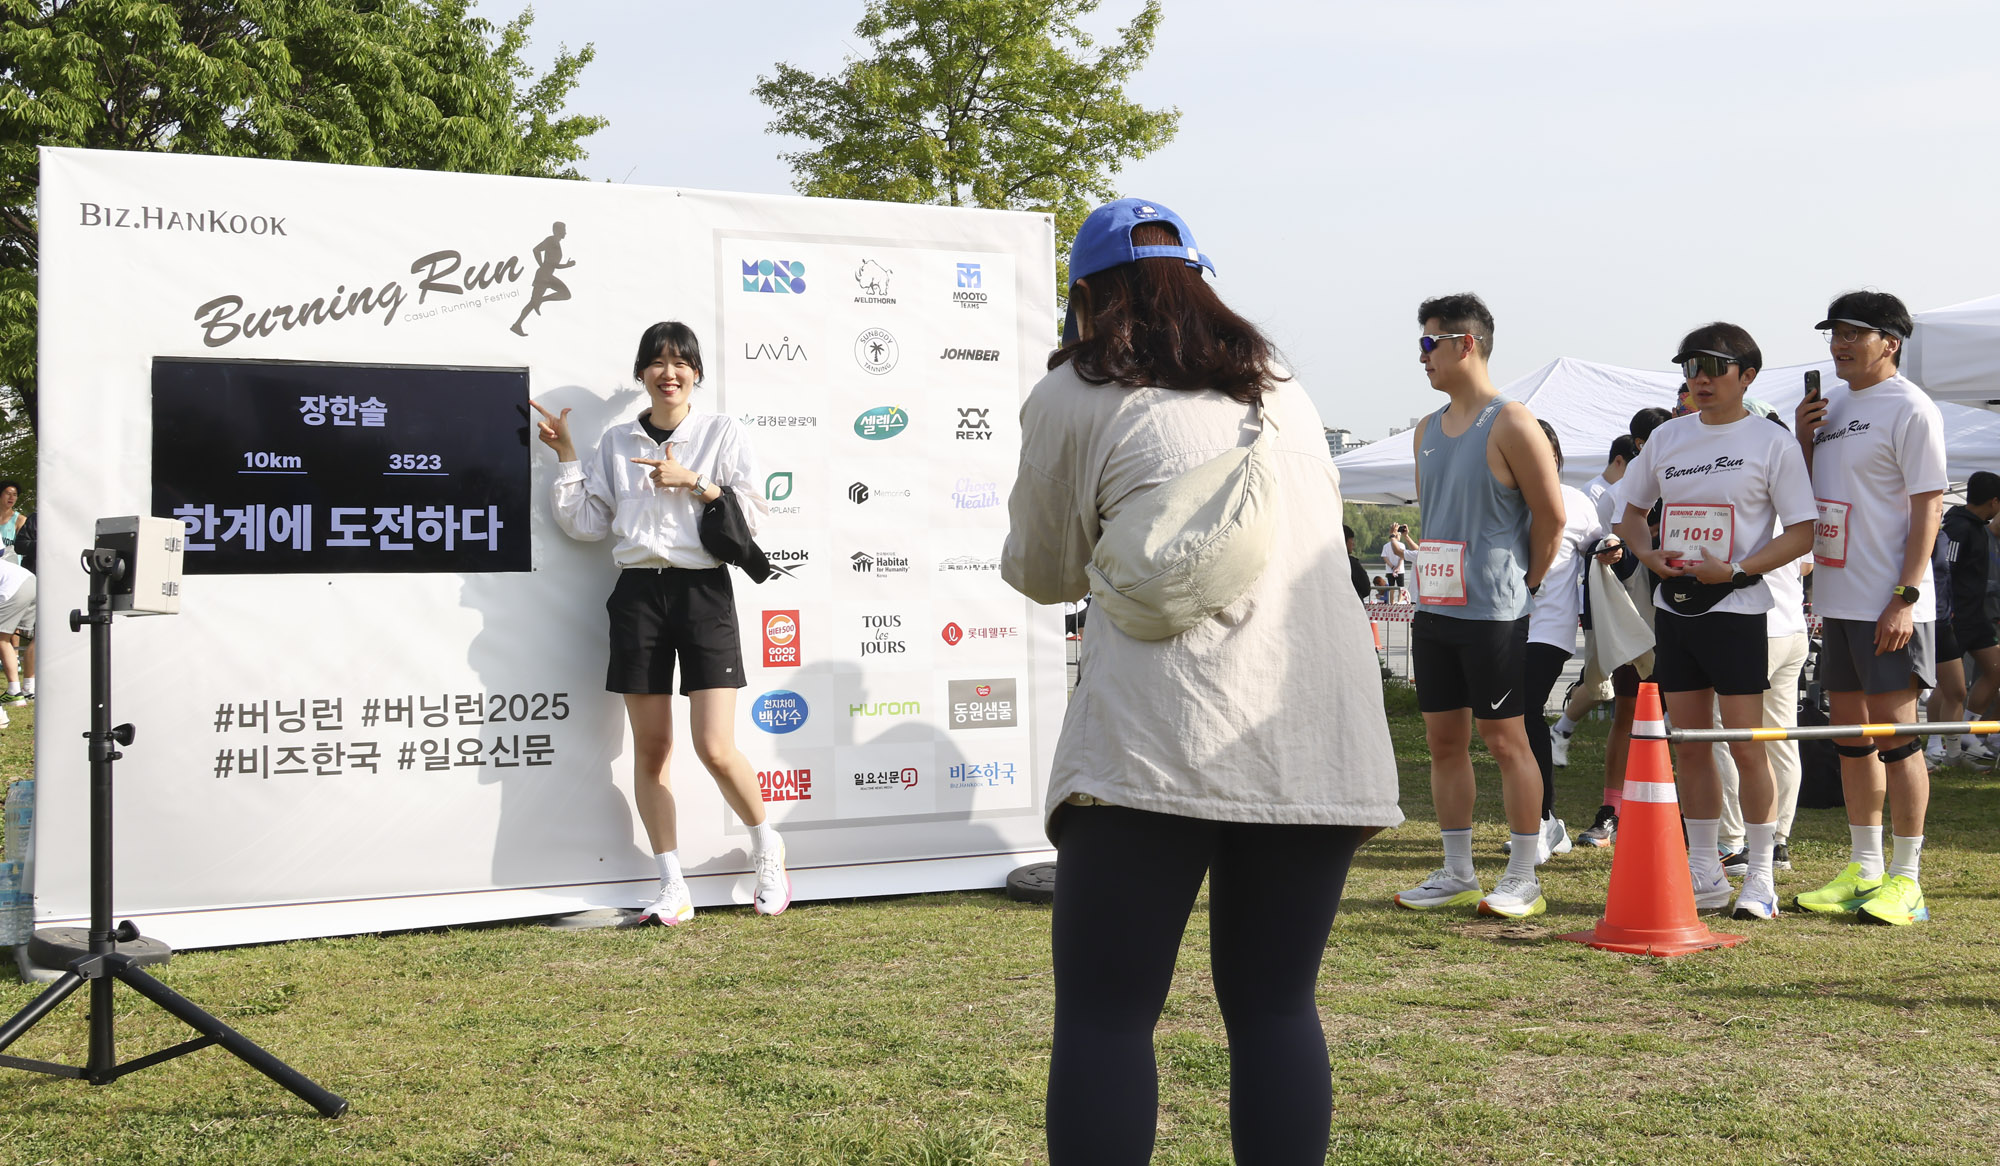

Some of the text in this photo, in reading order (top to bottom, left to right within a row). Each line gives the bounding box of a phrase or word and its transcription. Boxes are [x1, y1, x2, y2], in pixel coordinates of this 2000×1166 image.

[194, 250, 525, 348] Burning Run
[953, 291, 988, 301] MOOTO
[404, 289, 521, 323] Casual Running Festival
[961, 301, 980, 309] TEAMS
[860, 330, 893, 345] SUNBODY
[940, 348, 1000, 361] JOHNBER
[863, 361, 892, 373] TANNING
[299, 394, 388, 428] 장한솔
[756, 415, 817, 427] 김정문알로에
[860, 413, 905, 435] 셀렉스
[1848, 419, 1871, 434] Run
[956, 431, 993, 440] REXY
[243, 452, 302, 469] 10km
[389, 454, 442, 470] 3523
[1665, 463, 1713, 480] Burning
[1714, 456, 1745, 470] Run
[955, 478, 997, 493] Choco
[951, 491, 1000, 509] Health
[173, 503, 504, 552] 한계에 도전하다
[1669, 527, 1724, 541] M 1019
[763, 550, 809, 561] eebok
[876, 557, 909, 567] Habitat
[1425, 563, 1455, 577] 1515
[862, 615, 901, 628] TOUS
[875, 628, 889, 641] les
[968, 627, 1018, 639] 롯데웰푸드
[768, 647, 796, 655] GOOD
[860, 641, 906, 657] JOURS
[769, 654, 795, 663] LUCK
[763, 698, 796, 709] 천지차이
[213, 692, 570, 734] #버닝런 #버닝런2025
[758, 710, 802, 727] 백산수
[953, 701, 1013, 723] 동원샘물
[213, 734, 556, 780] #비즈한국 #일요신문
[854, 771, 900, 786] 일요신문
[949, 761, 1017, 786] 비즈한국
[756, 768, 811, 802] 일요신문
